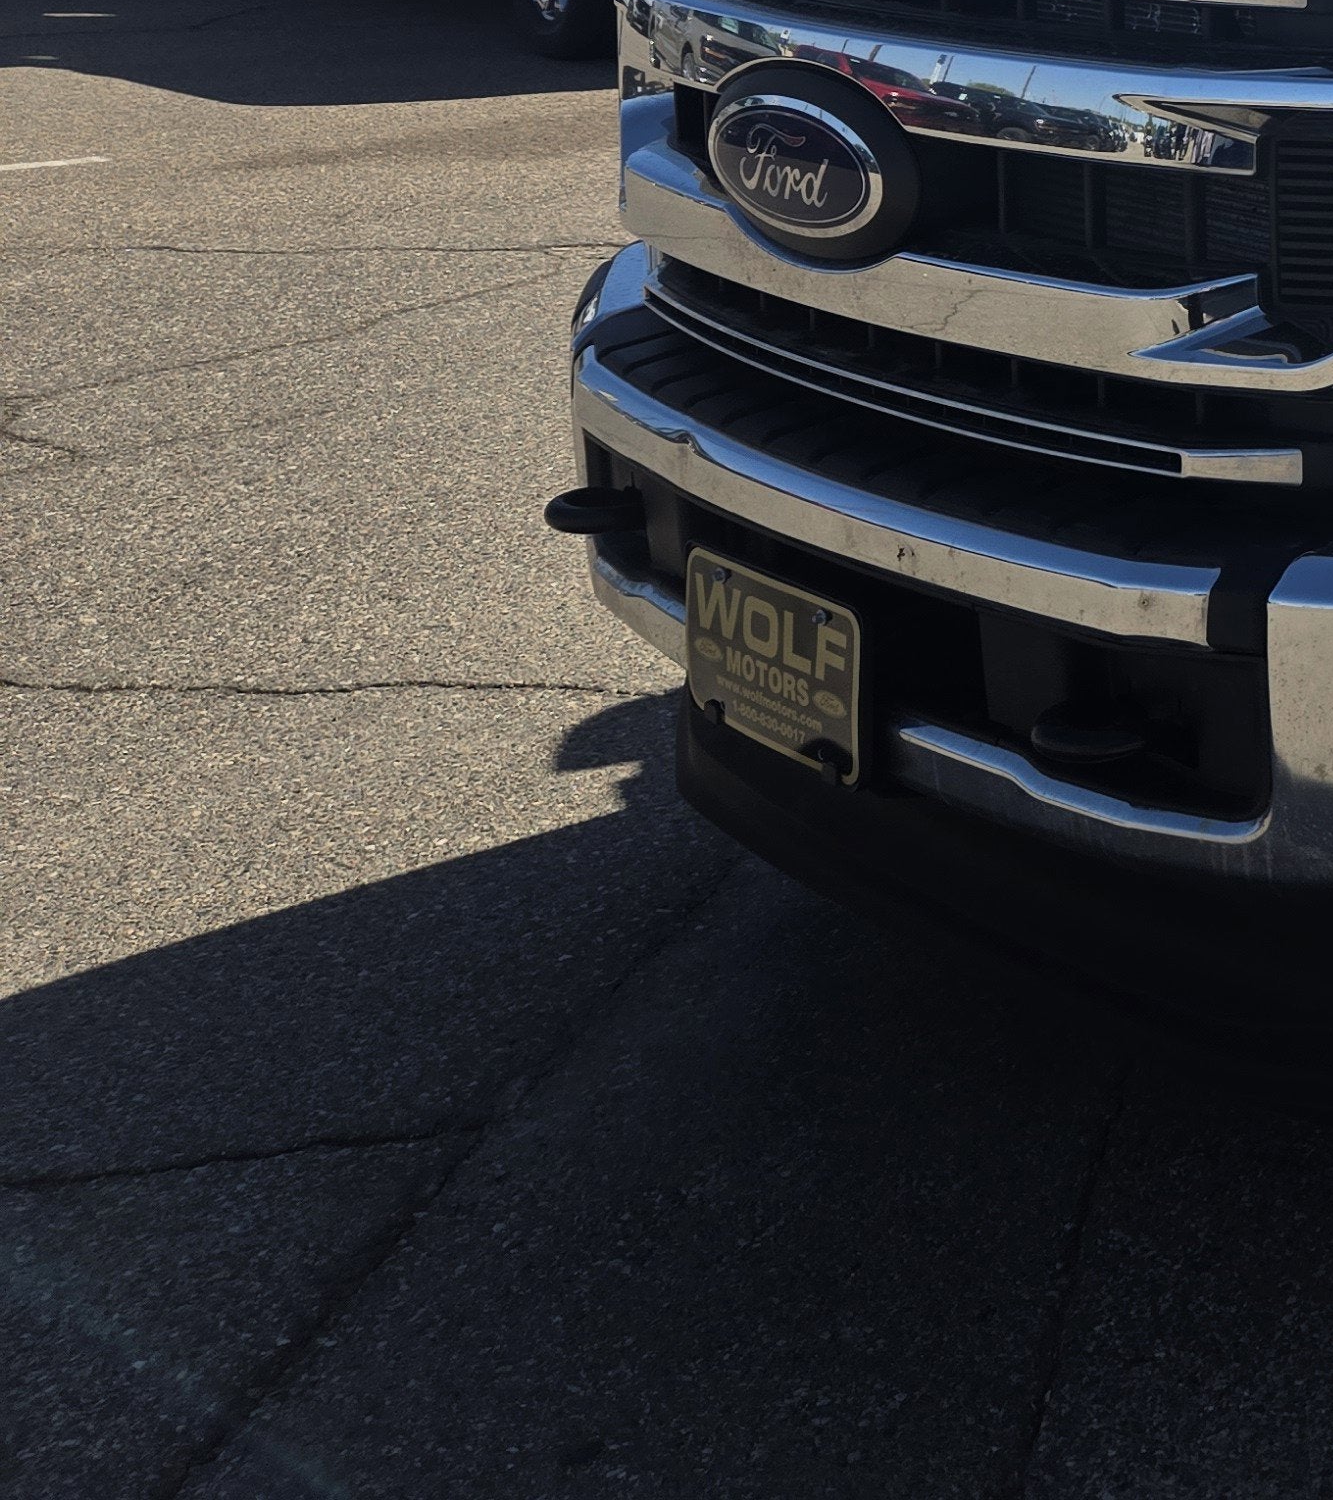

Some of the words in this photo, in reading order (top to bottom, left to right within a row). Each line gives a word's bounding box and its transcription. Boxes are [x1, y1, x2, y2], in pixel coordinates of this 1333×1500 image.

[739, 123, 829, 208] Ford
[695, 572, 847, 681] WOLF
[726, 646, 810, 707] MOTORS
